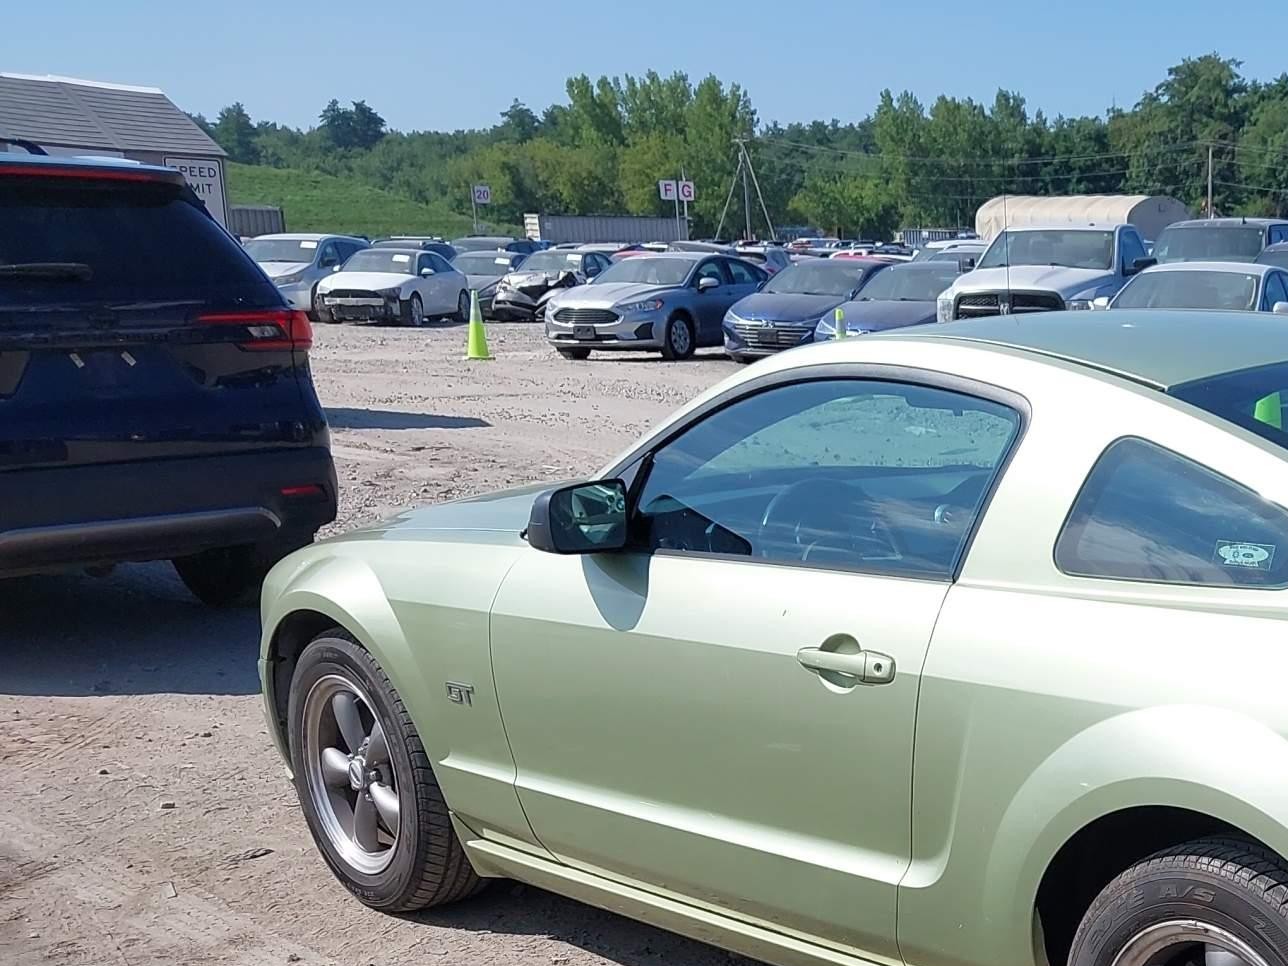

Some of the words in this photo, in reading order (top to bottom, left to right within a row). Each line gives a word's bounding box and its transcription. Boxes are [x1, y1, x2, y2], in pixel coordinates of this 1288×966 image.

[171, 166, 216, 177] PEED
[190, 183, 212, 194] MIT
[476, 190, 489, 200] 20
[664, 184, 671, 197] F
[682, 184, 692, 198] G
[445, 680, 475, 707] GT
[1159, 883, 1217, 903] A/S
